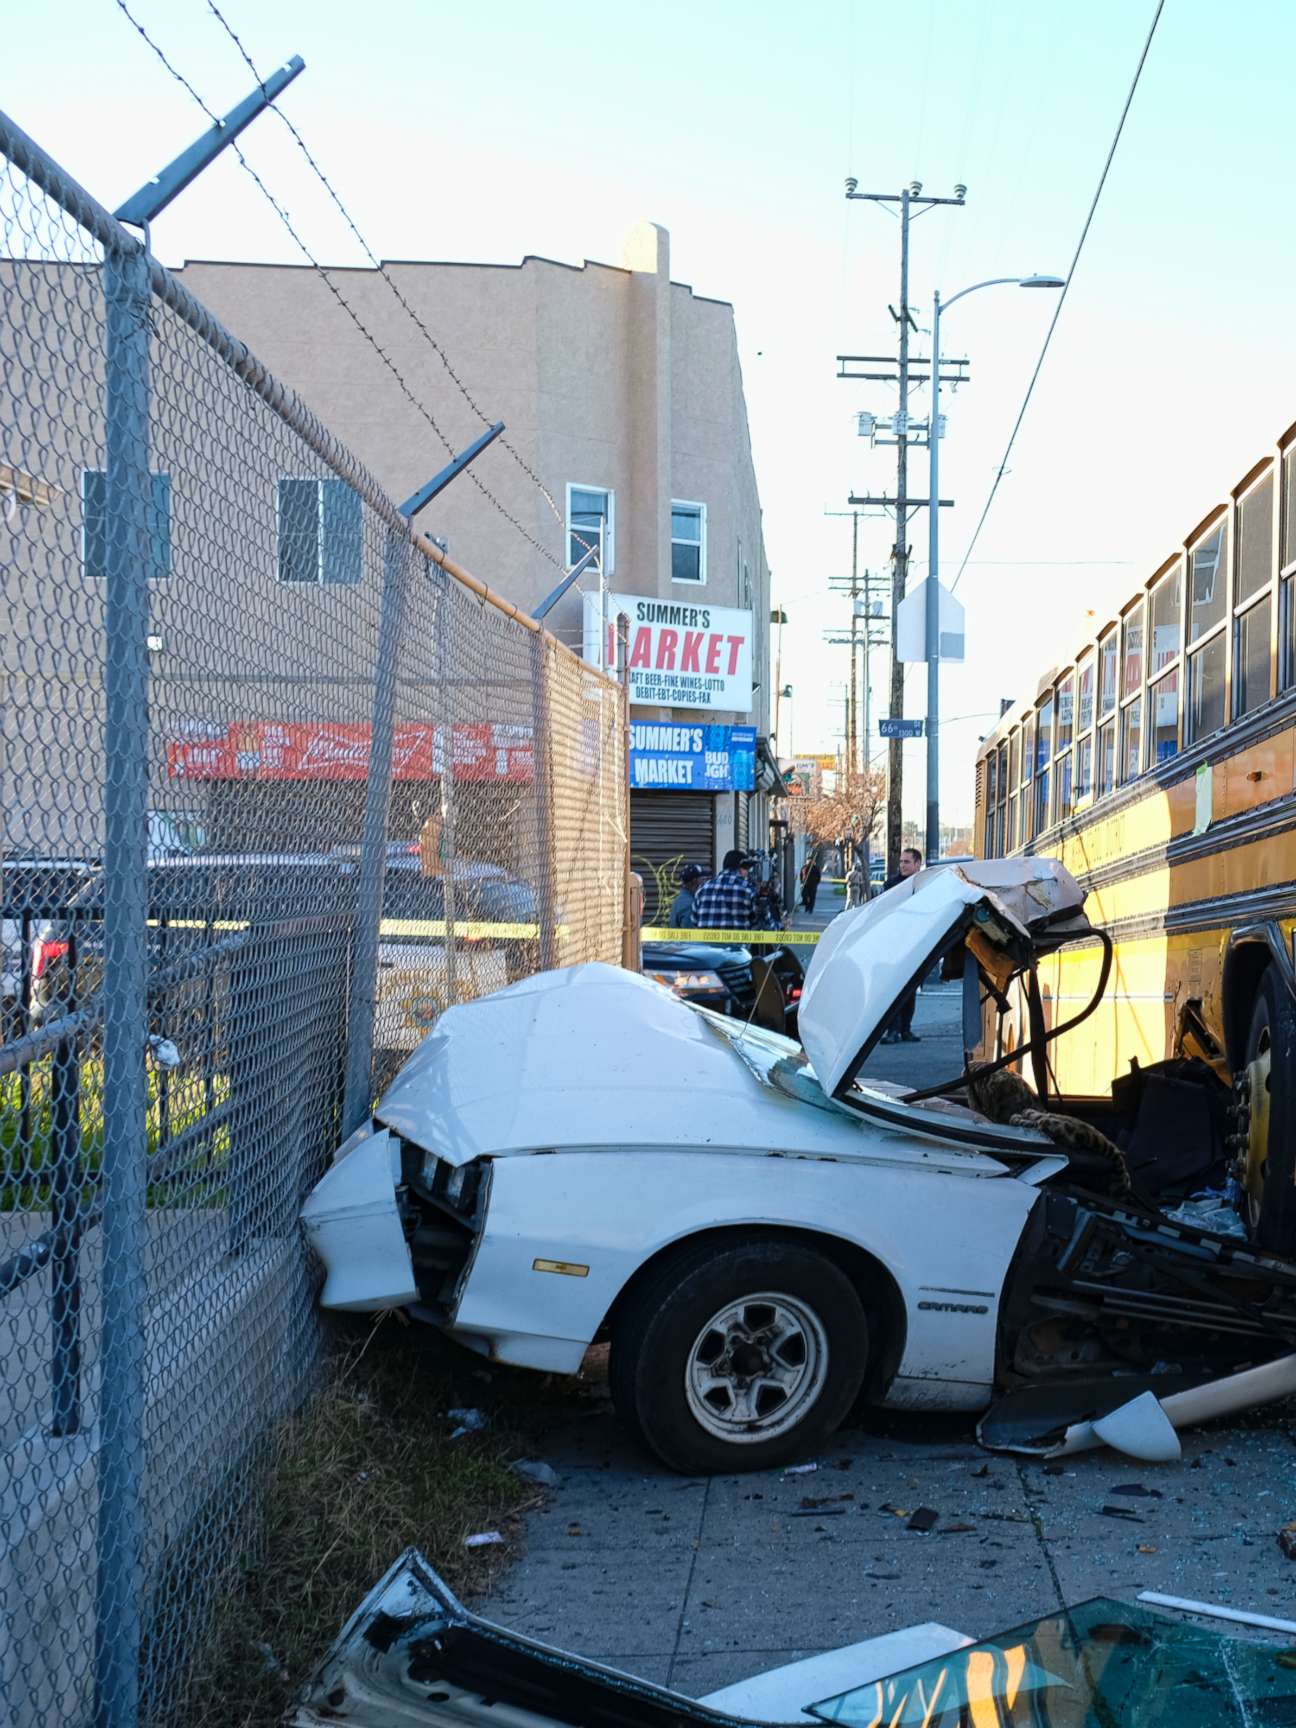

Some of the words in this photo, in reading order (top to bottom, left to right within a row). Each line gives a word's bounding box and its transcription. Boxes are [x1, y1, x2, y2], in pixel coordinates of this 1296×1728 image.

[636, 602, 710, 629] SUMMER'S
[629, 725, 703, 753] SUMMER'S
[704, 751, 729, 764] BUD
[634, 758, 694, 784] MARKET
[917, 1301, 989, 1315] CAMARO
